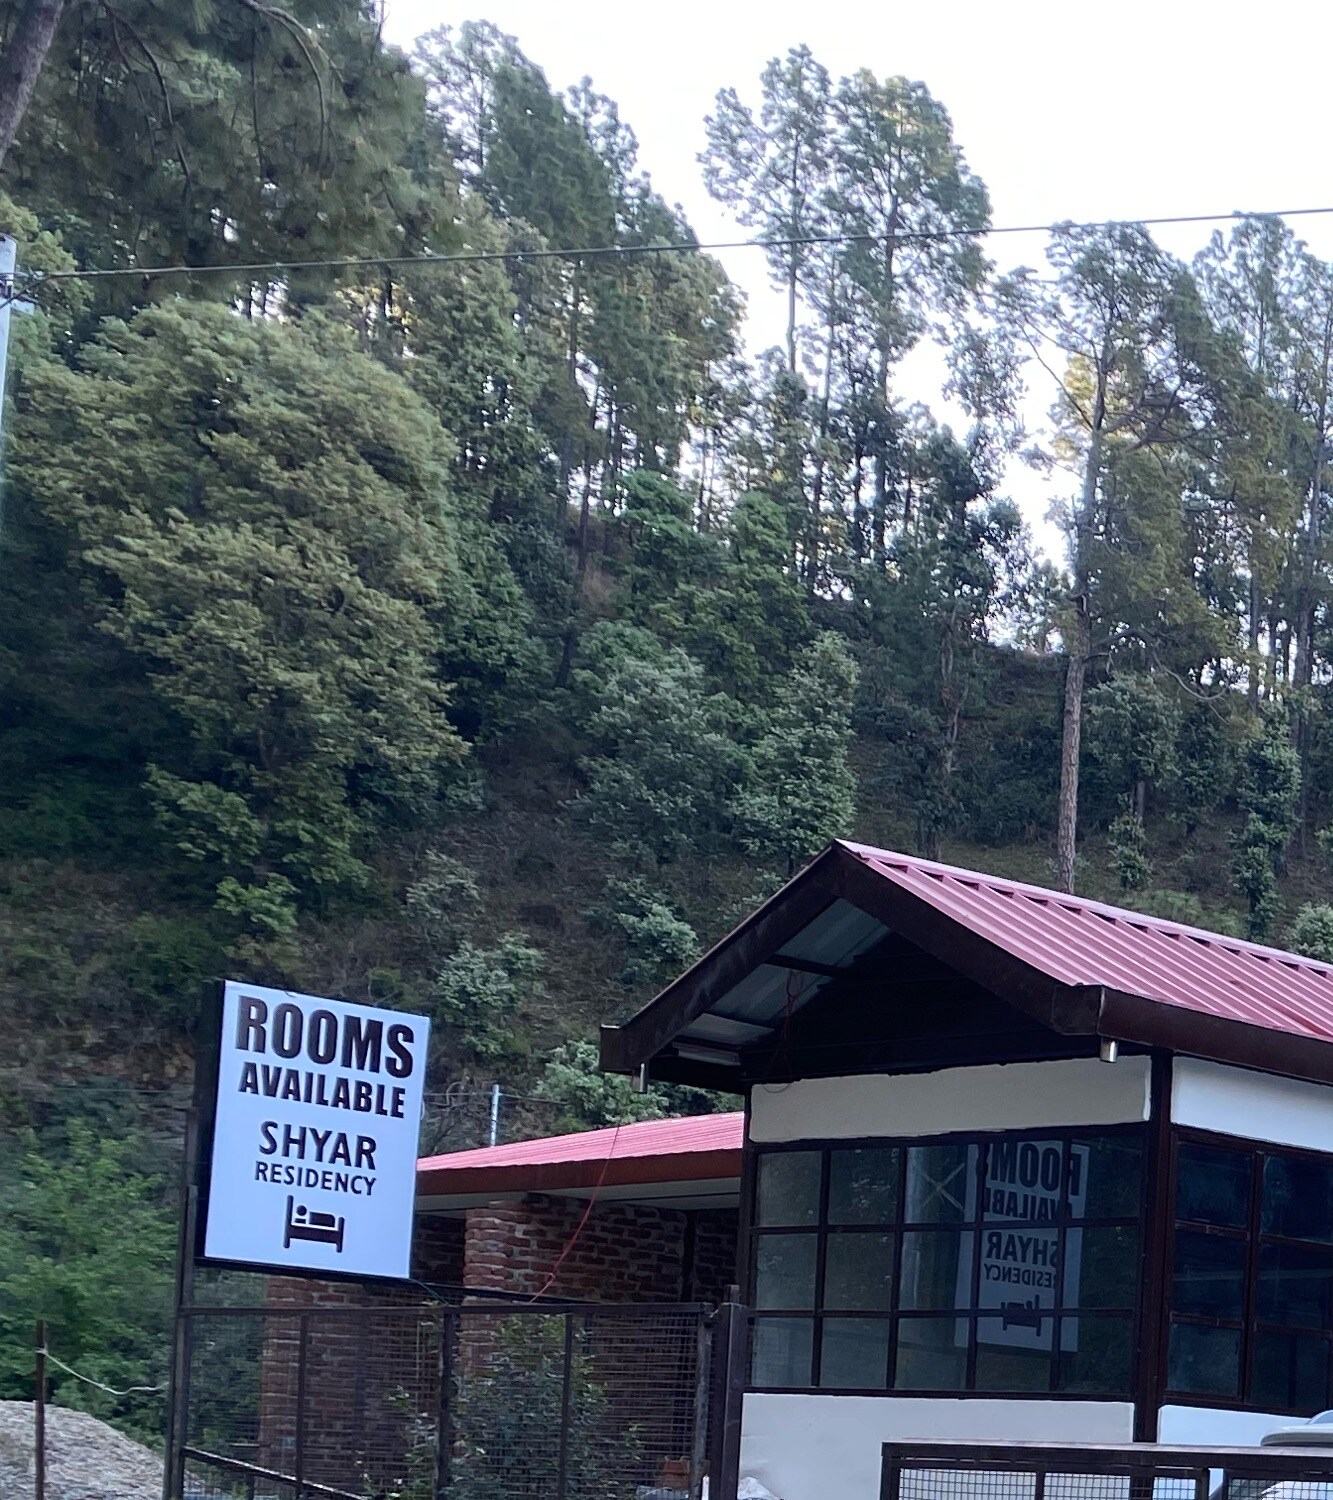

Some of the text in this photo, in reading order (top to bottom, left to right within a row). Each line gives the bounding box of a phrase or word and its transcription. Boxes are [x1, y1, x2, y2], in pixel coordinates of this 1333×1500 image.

[235, 995, 415, 1079] ROOMS
[238, 1061, 405, 1119] AVAILABLE
[259, 1120, 377, 1170] SHYAR
[255, 1160, 377, 1196] RESIDENCY
